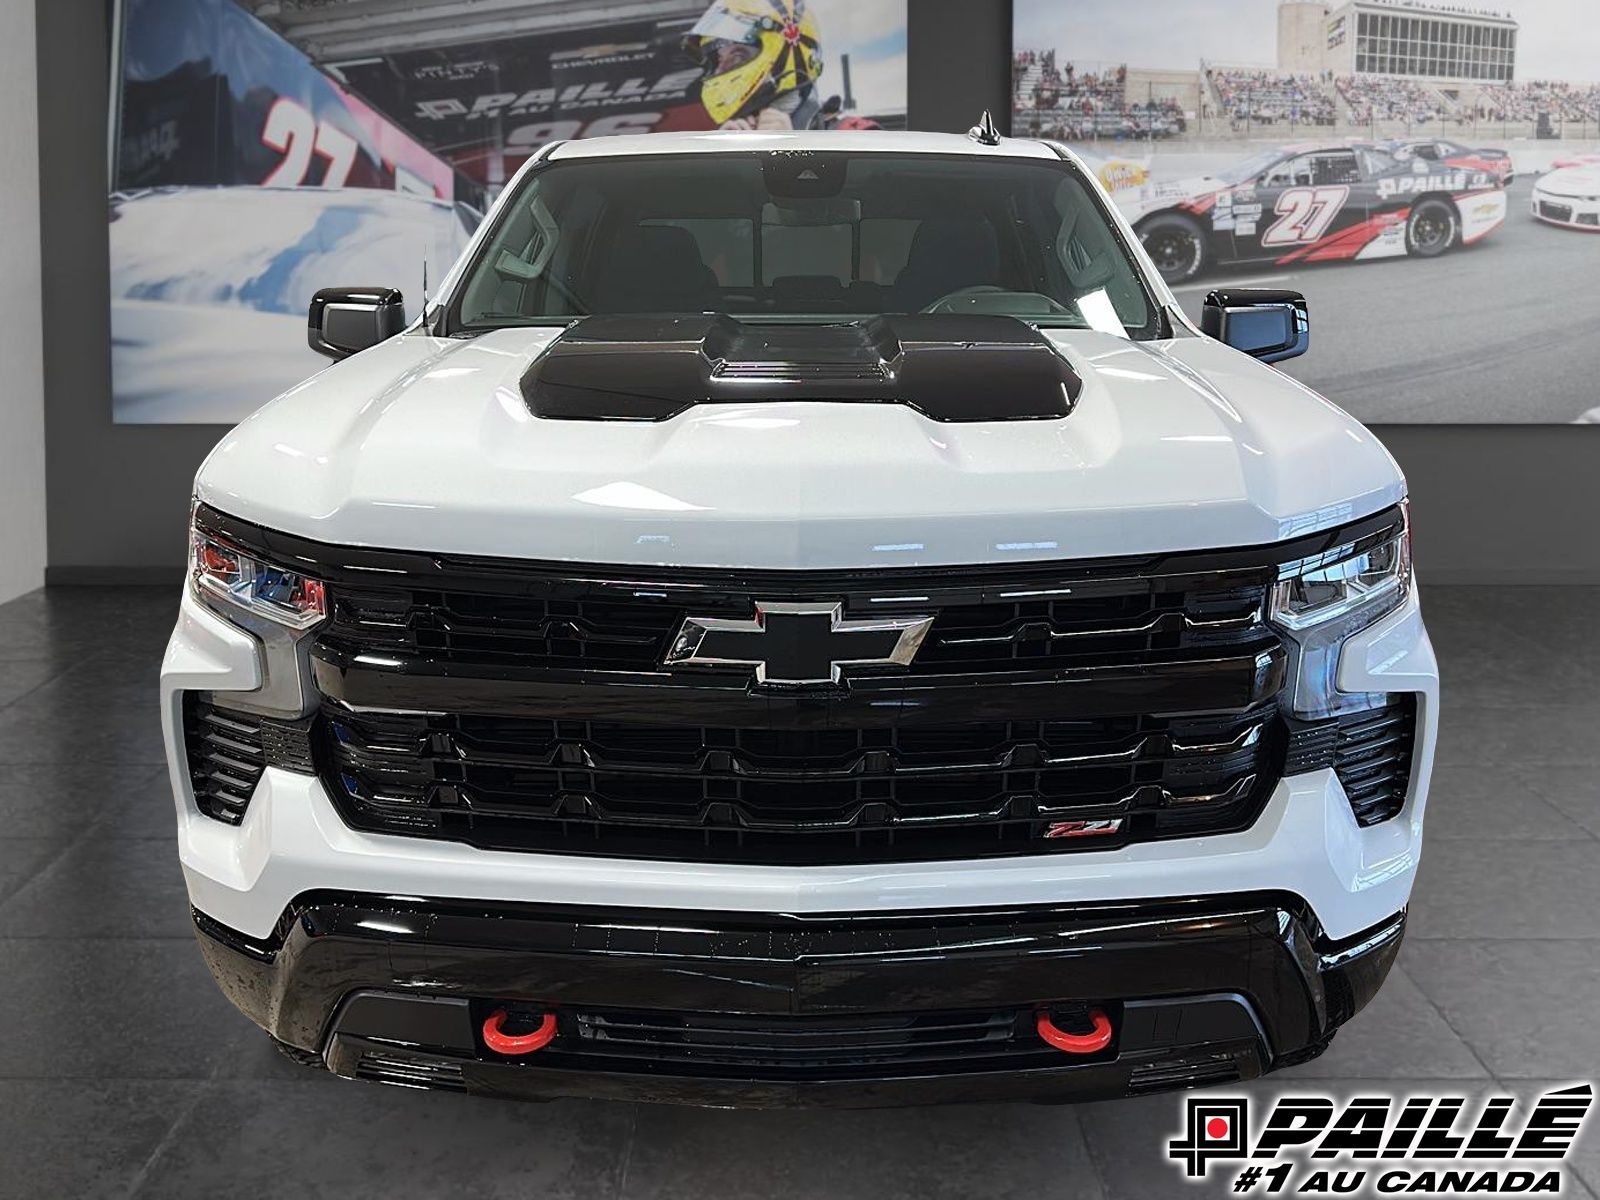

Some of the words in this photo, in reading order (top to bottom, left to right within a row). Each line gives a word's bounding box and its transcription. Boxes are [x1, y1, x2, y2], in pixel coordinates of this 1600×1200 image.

[261, 95, 359, 188] 27
[1261, 184, 1350, 247] 27
[1043, 818, 1123, 838] Z71
